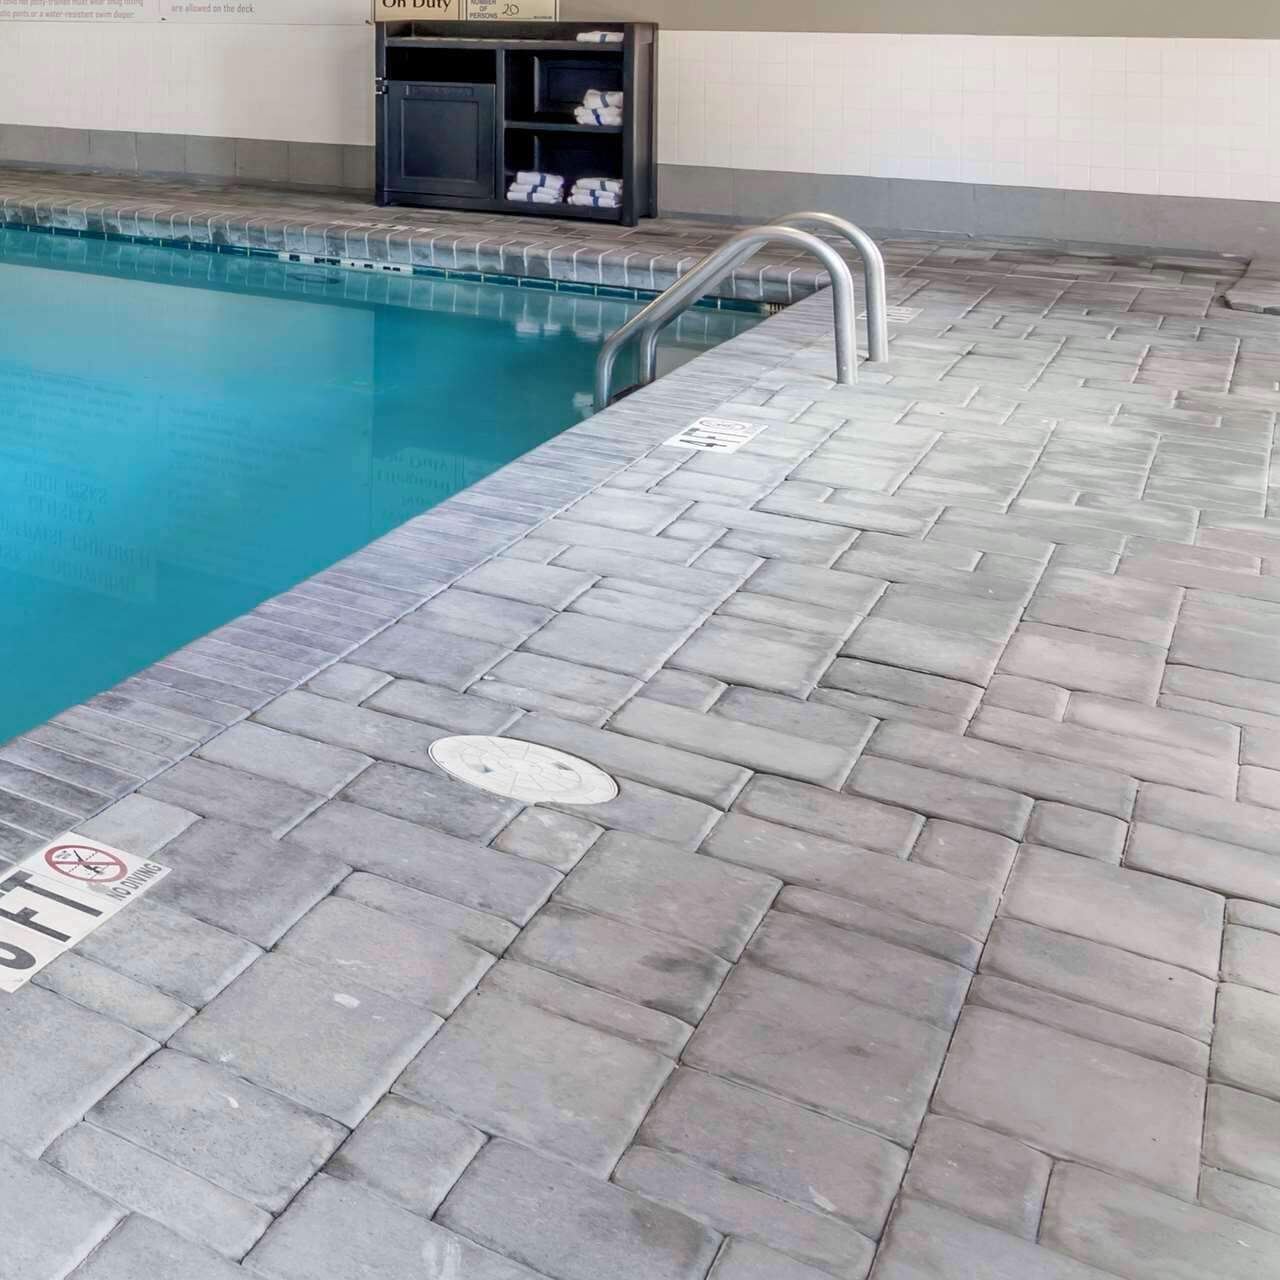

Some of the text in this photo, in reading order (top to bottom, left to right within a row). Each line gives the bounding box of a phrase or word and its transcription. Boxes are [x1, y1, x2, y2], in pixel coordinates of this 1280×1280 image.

[223, 3, 235, 13] the
[502, 3, 520, 16] 20
[105, 863, 162, 901] NO DIVING
